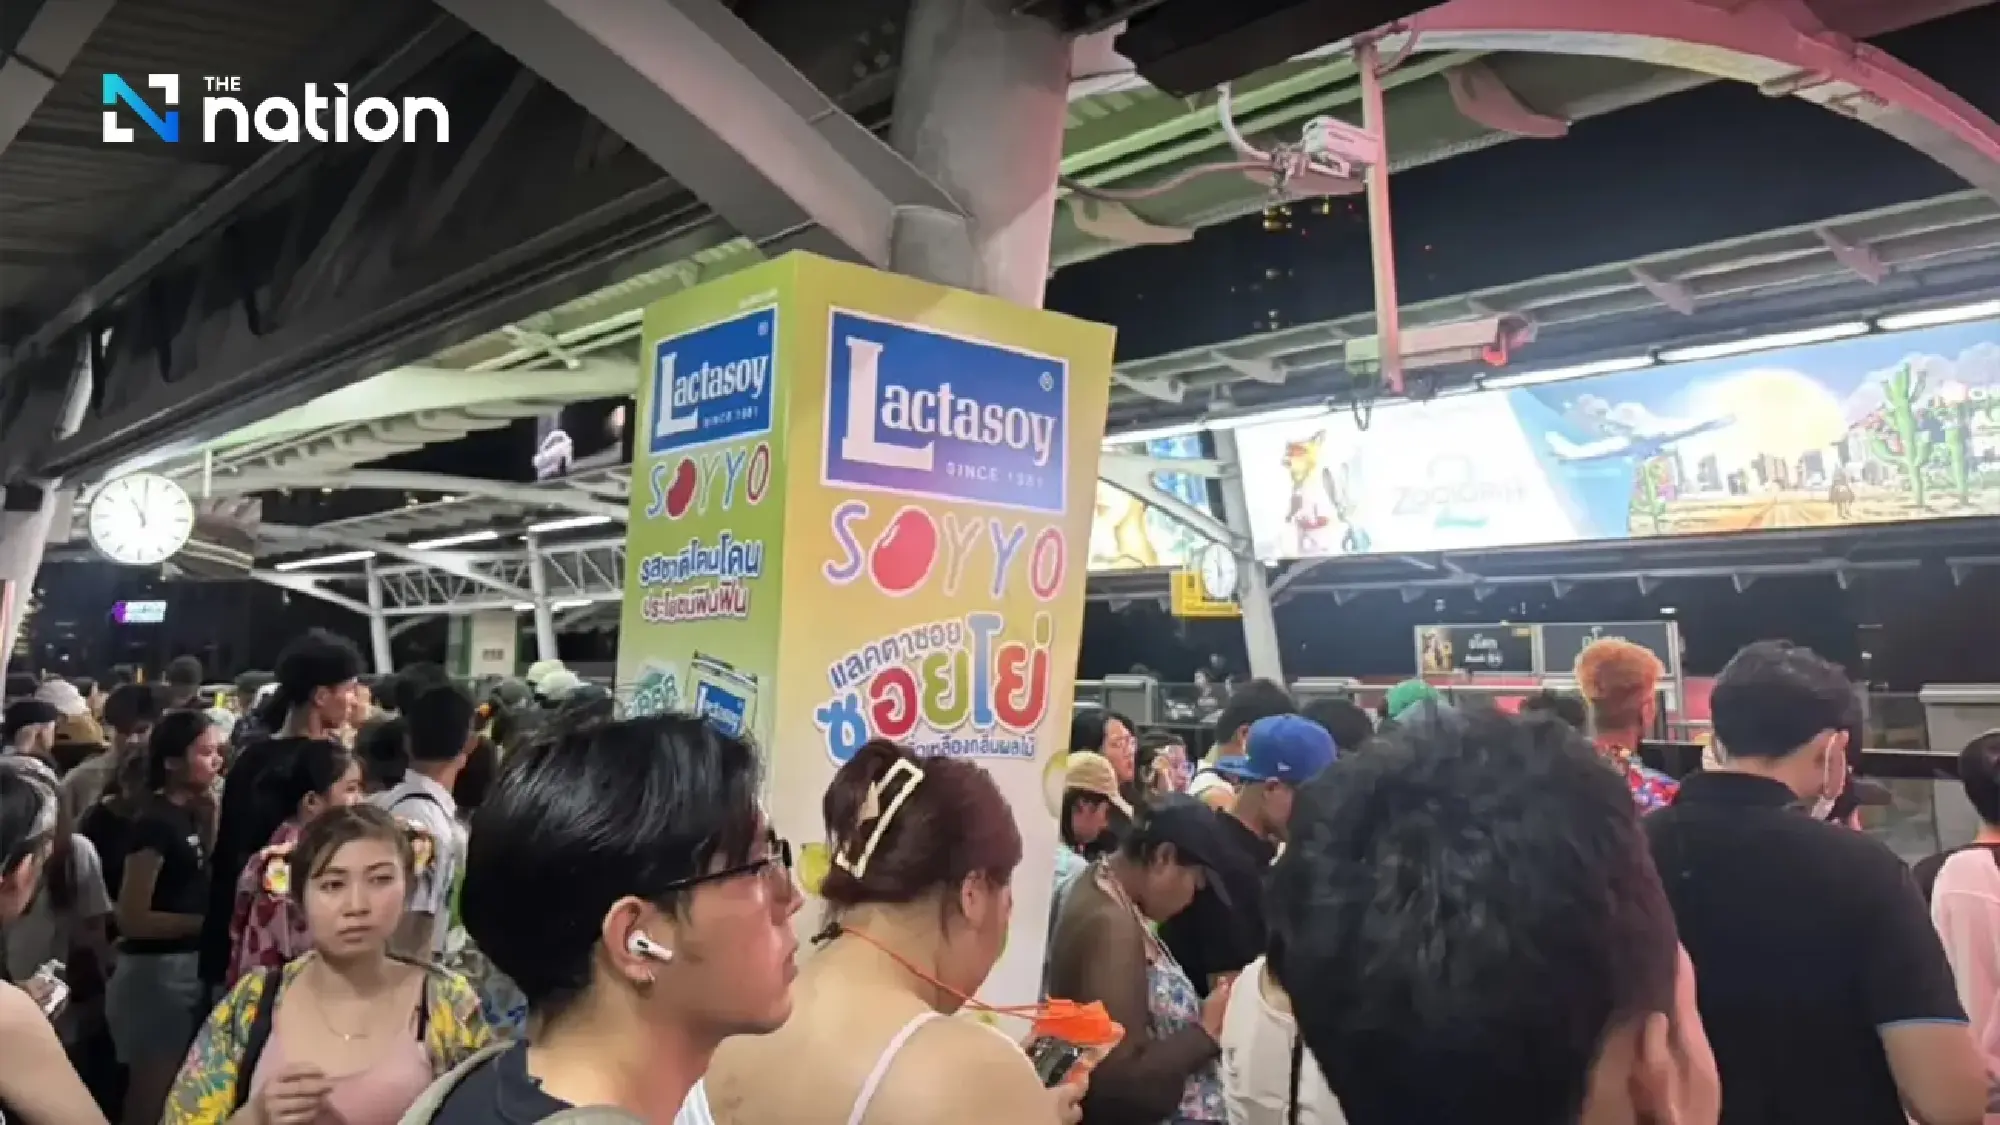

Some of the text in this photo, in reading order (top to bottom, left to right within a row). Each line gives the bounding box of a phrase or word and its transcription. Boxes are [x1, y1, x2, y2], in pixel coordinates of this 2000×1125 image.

[656, 351, 769, 437] Lactasoy
[841, 335, 1057, 472] Lactasoy
[945, 461, 999, 482] SINCE
[816, 612, 1050, 761] ซอยโย่
[829, 621, 962, 690] แลคตาซอย
